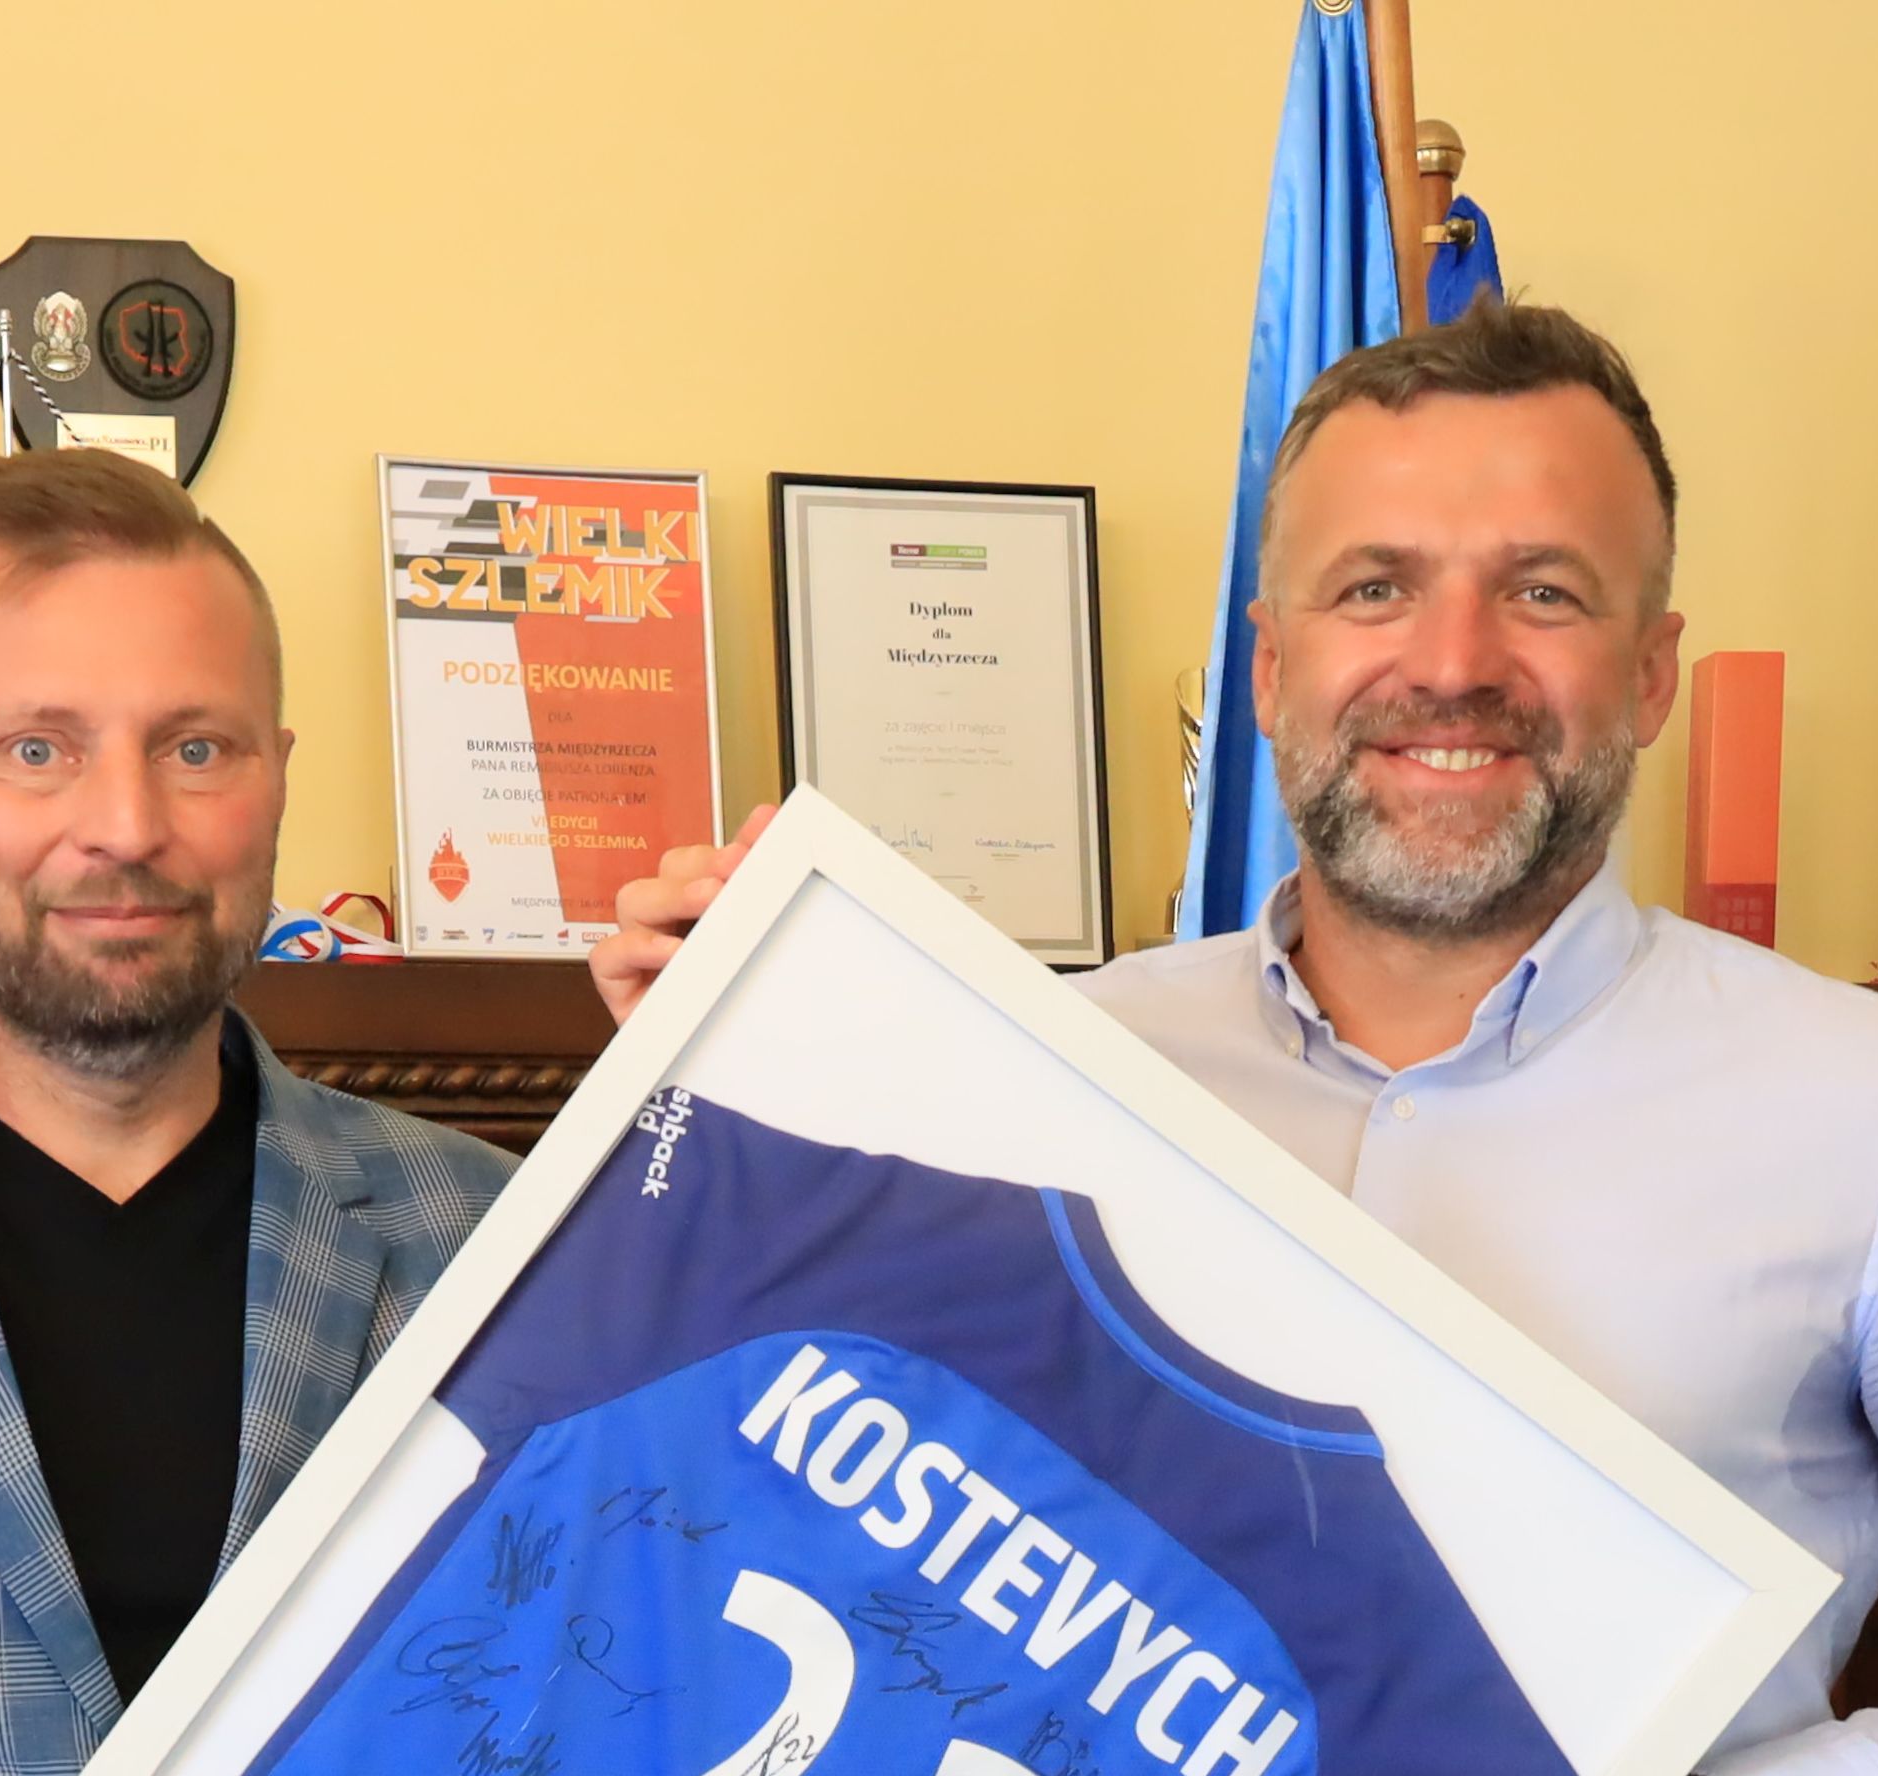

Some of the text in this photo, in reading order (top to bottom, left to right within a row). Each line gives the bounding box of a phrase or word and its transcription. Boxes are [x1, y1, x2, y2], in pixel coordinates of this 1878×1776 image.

[497, 502, 701, 562] WIELKI
[407, 557, 673, 619] SZLEMIK
[910, 601, 973, 620] Dyplom
[932, 627, 952, 640] dla
[887, 647, 999, 667] Międzyrzecza
[443, 661, 674, 693] PODZIĘKOWANIE
[547, 711, 573, 723] DLA
[466, 739, 657, 758] BURMISTRZA MIĘDZYRZECZA
[471, 758, 507, 772] PANA
[482, 788, 500, 800] ZA
[487, 832, 648, 850] WIELKIEGO SZLEMIKA
